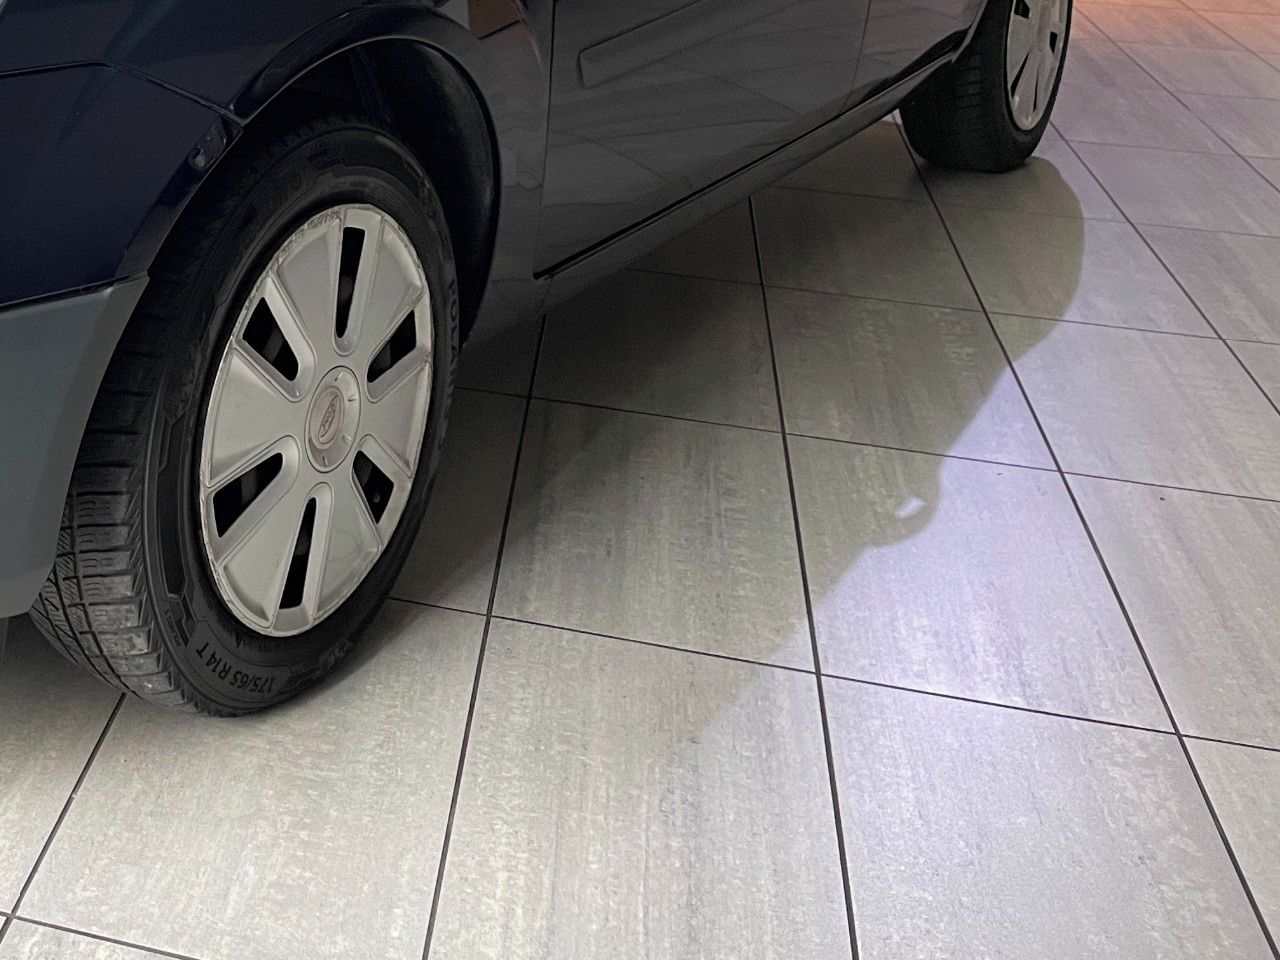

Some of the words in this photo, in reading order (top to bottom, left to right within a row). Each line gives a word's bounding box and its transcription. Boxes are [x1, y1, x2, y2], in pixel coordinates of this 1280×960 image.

[195, 642, 209, 659] T
[206, 651, 232, 680] R14
[229, 670, 276, 693] 175/65
